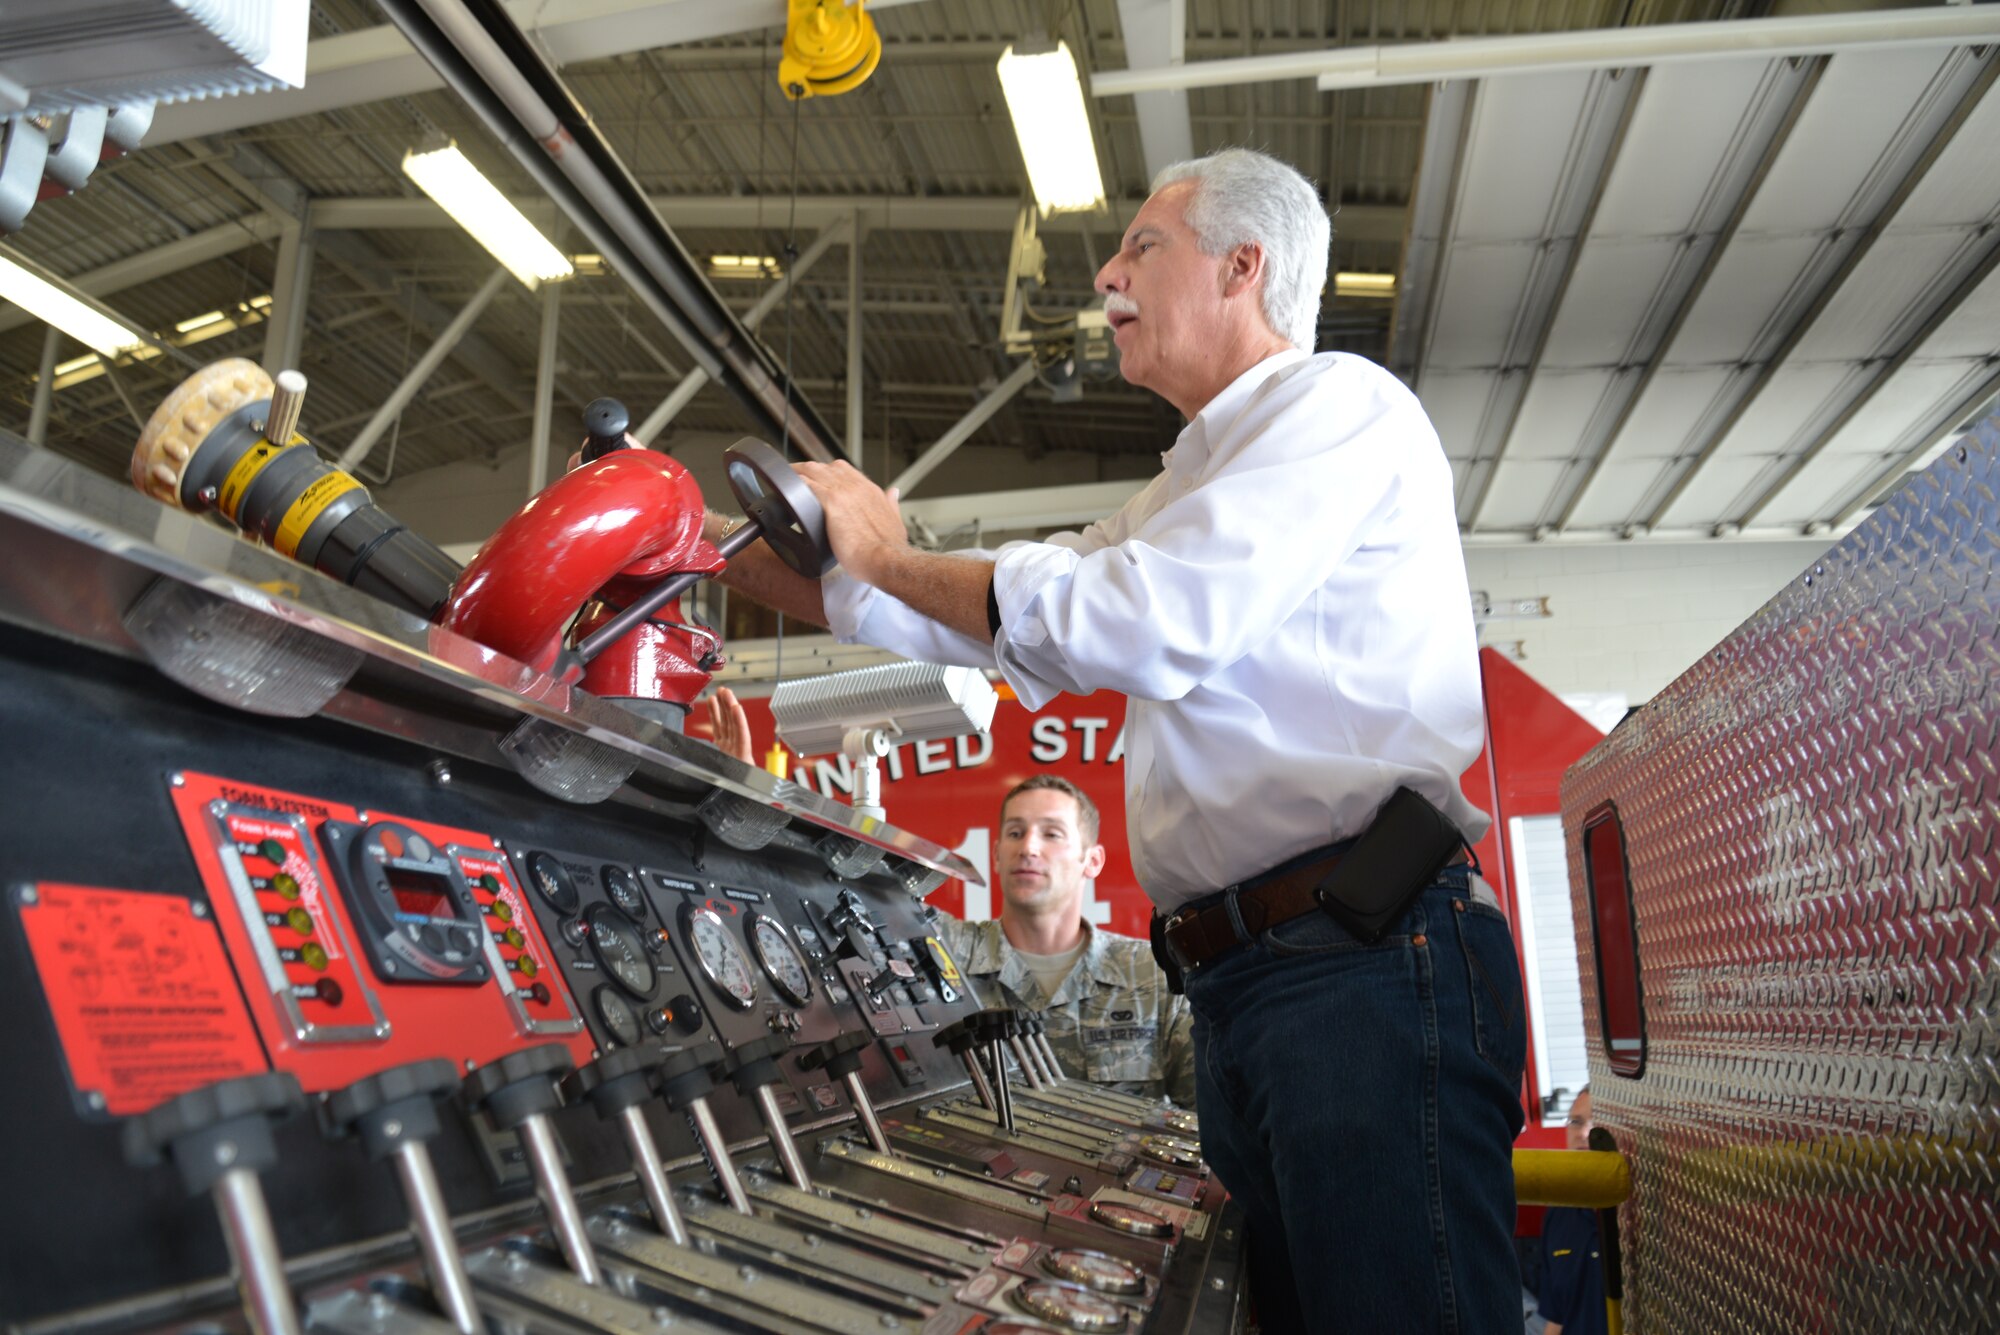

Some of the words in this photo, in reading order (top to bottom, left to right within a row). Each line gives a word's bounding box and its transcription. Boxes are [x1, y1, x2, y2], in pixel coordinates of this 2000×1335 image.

[793, 732, 993, 799] NTED
[221, 786, 267, 809] FOAM
[270, 796, 329, 818] SYSTEM
[231, 819, 264, 836] Foam
[264, 824, 296, 840] Level
[953, 827, 1112, 925] 1
[1110, 1029, 1128, 1041] AIR
